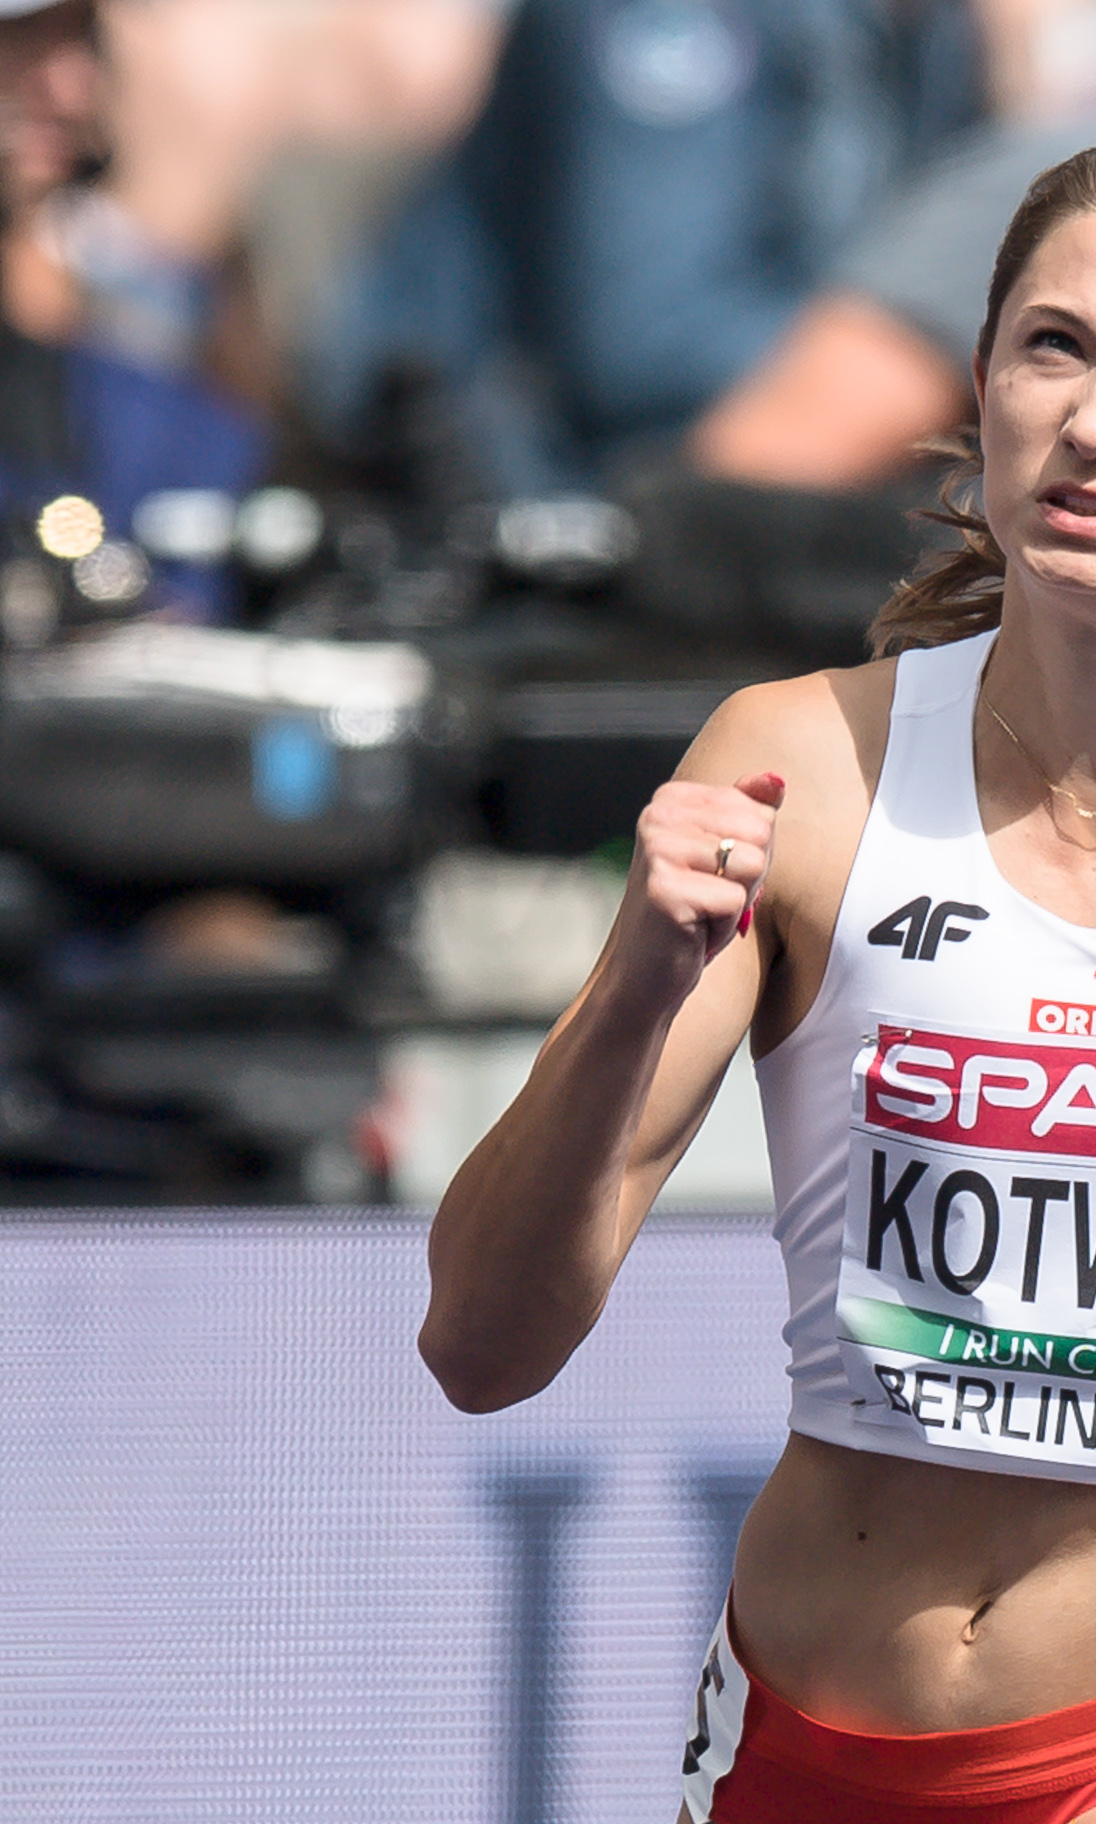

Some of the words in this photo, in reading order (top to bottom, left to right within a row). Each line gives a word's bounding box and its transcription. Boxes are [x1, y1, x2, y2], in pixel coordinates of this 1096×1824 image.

[867, 895, 990, 961] 4F
[939, 1323, 954, 1355] I
[962, 1329, 1052, 1370] RUN
